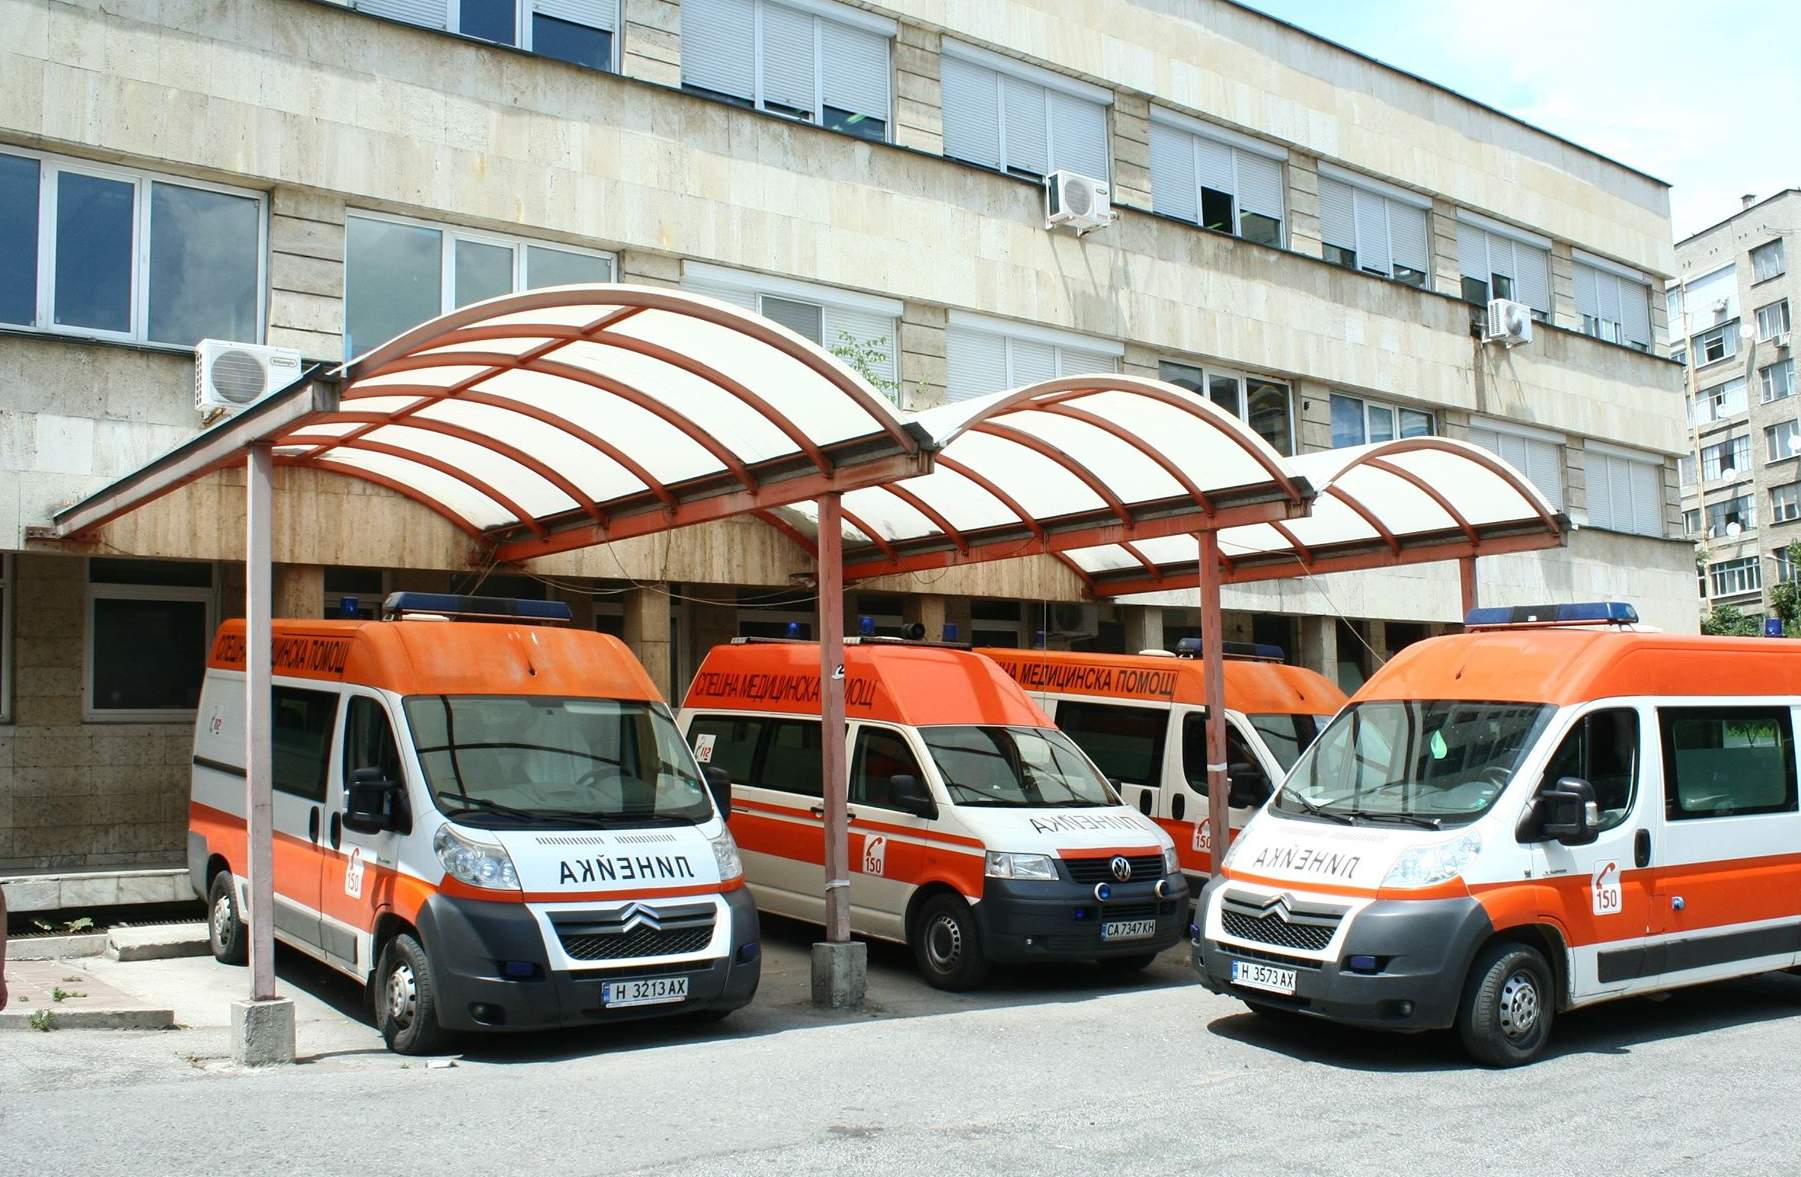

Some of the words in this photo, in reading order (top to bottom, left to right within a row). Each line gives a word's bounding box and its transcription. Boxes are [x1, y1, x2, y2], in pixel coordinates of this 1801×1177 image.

[216, 634, 247, 663] СПЕШН
[694, 672, 739, 698] СПЕШНА
[741, 674, 820, 703] МЕДИЦИНСКА
[843, 677, 877, 709] МОЩ
[1021, 663, 1112, 692] МЕДИЦИНСКА
[1115, 670, 1176, 697] ПОМОЩ
[865, 857, 882, 873] 150
[347, 872, 360, 892] 150
[1596, 889, 1617, 910] 150
